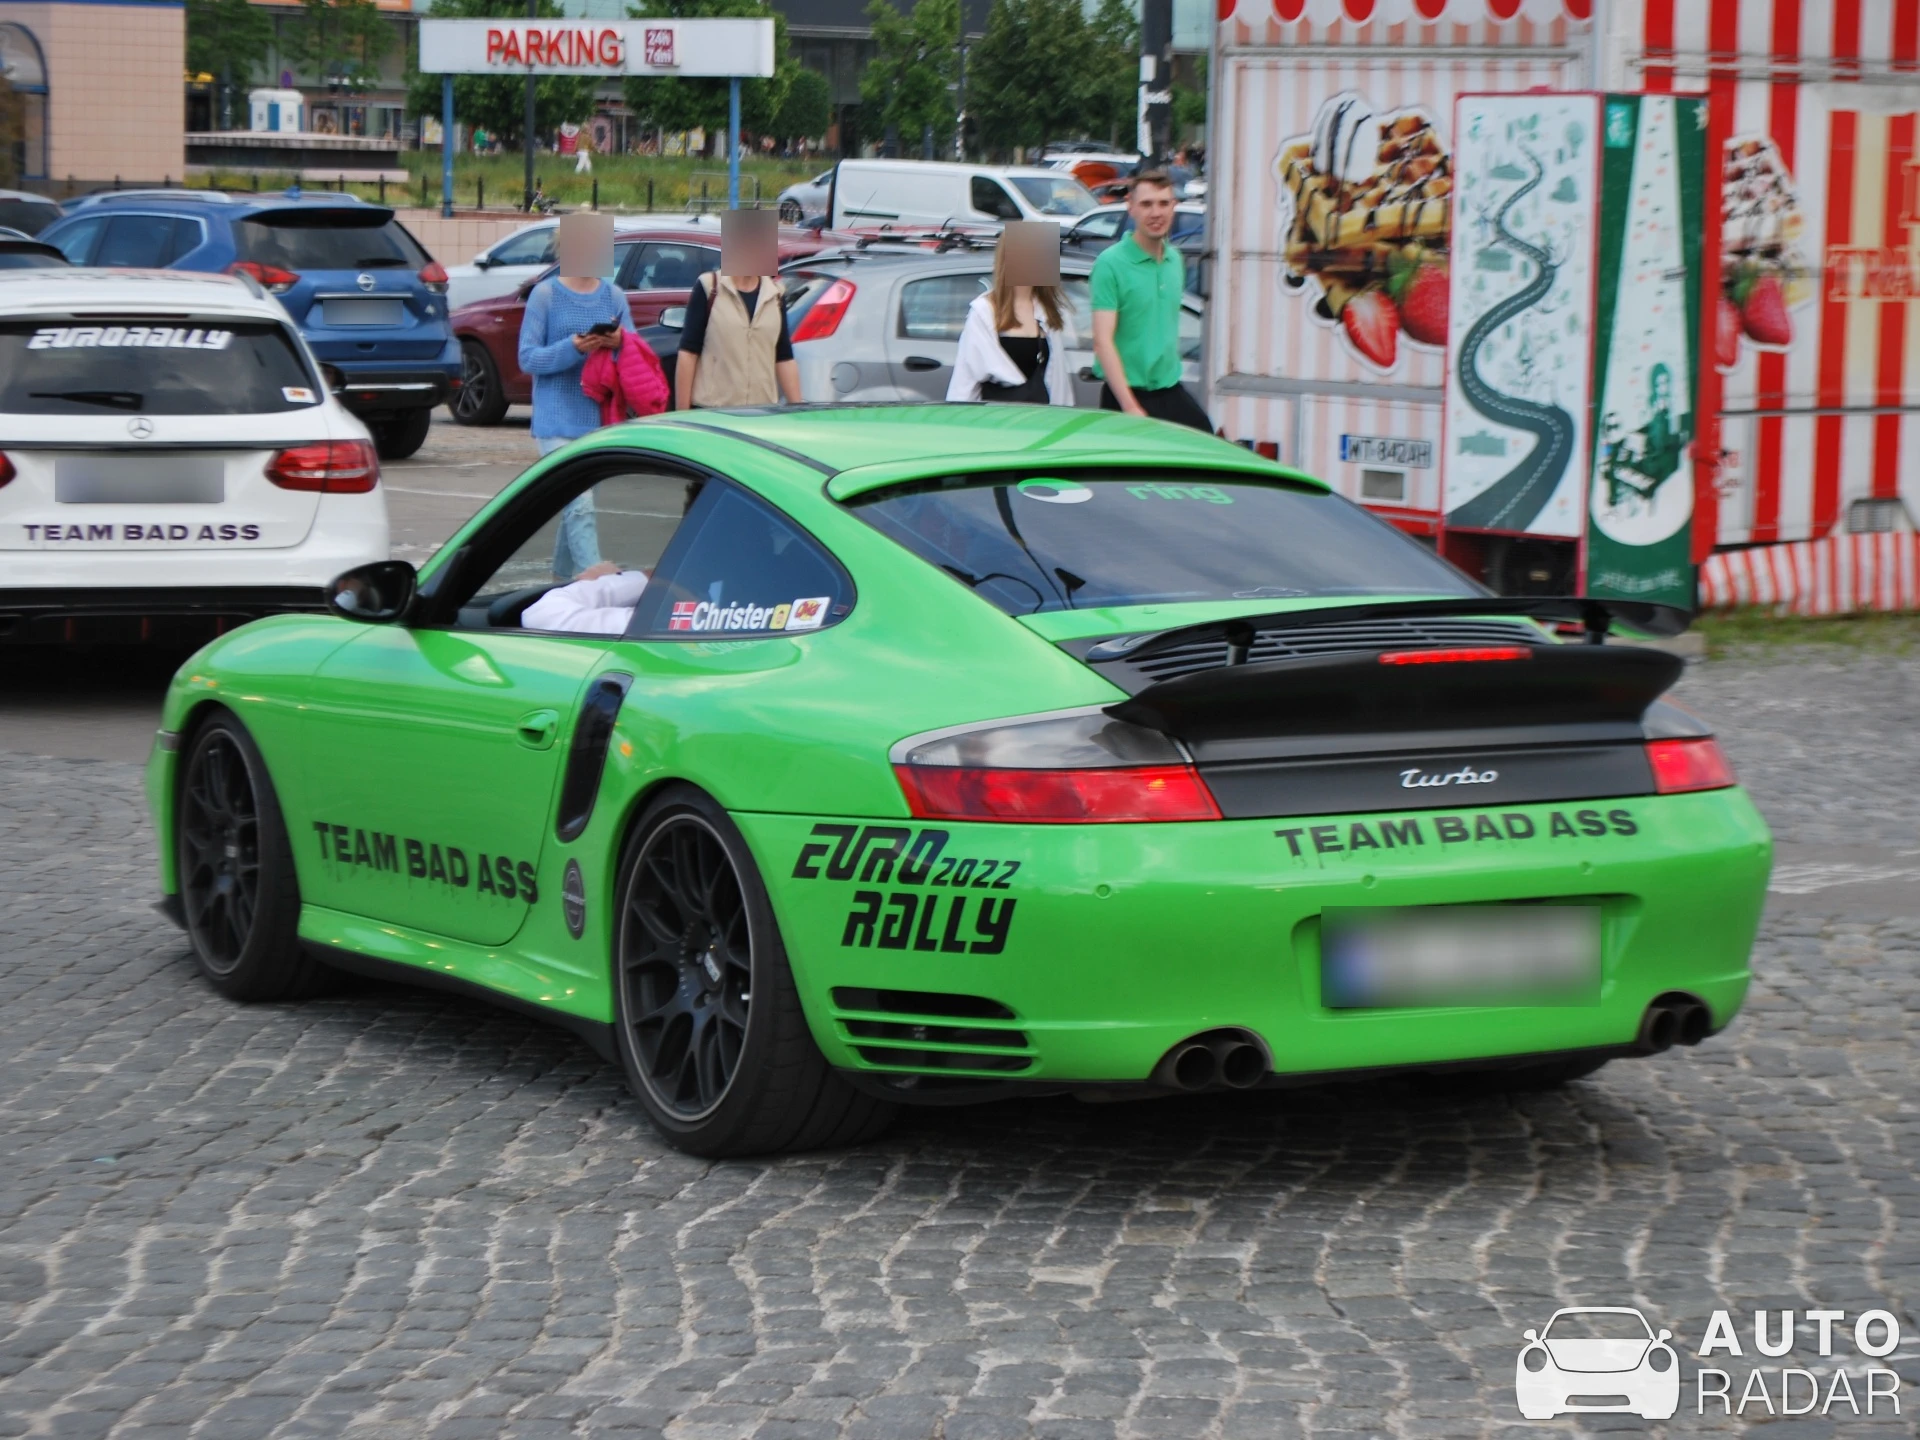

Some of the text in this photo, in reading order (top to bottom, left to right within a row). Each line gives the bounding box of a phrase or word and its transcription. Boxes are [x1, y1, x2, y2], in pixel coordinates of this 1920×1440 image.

[486, 29, 620, 67] PARKING
[1126, 483, 1234, 505] ring
[24, 524, 260, 541] TEAM BAD ASS
[691, 601, 774, 630] Christer
[1400, 766, 1499, 788] Turbo
[1274, 809, 1639, 857] TEAM BAD ASS
[312, 821, 538, 905] TEAM BAD ASS
[930, 857, 1021, 889] 2022
